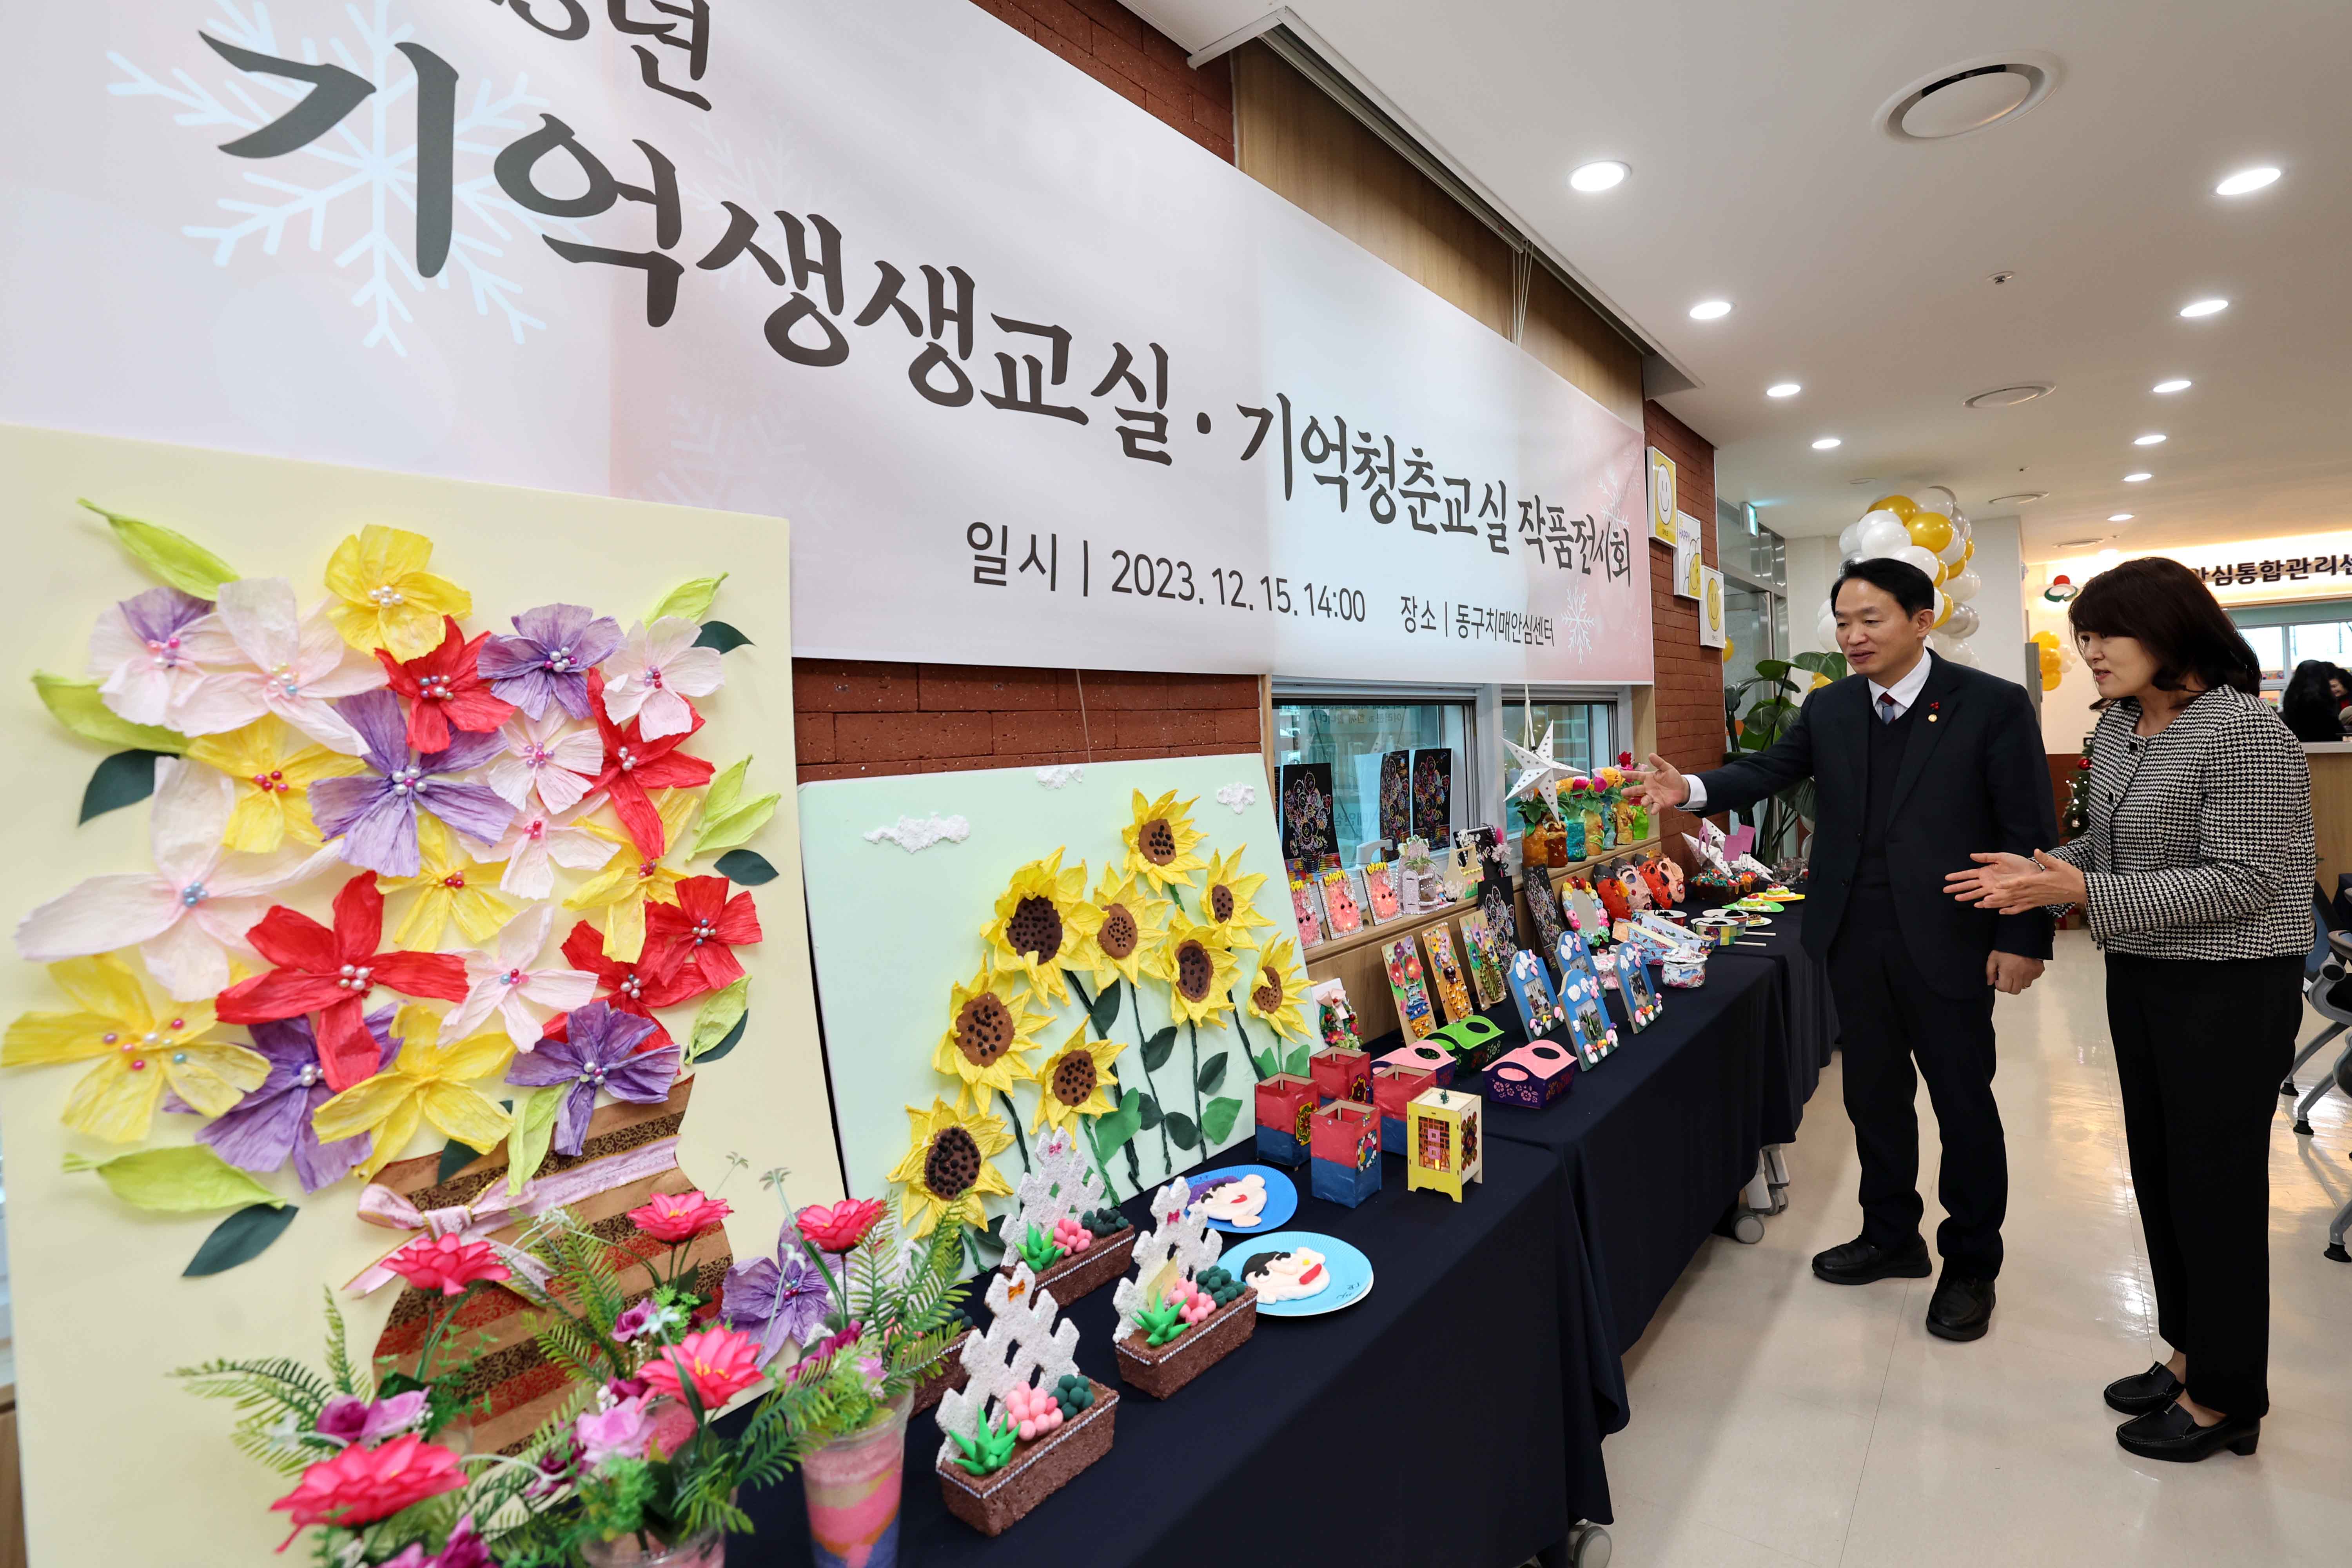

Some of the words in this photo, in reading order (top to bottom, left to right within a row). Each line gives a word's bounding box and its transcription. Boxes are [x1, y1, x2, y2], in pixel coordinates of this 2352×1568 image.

[199, 29, 1173, 466] 기억생생교실
[1236, 392, 1510, 555] 기억청춘교실
[1517, 494, 1632, 588] 작품전시회
[966, 522, 1056, 591] 일시
[1400, 595, 1437, 635] 장소
[1455, 604, 1555, 647] 동구치매안심센터
